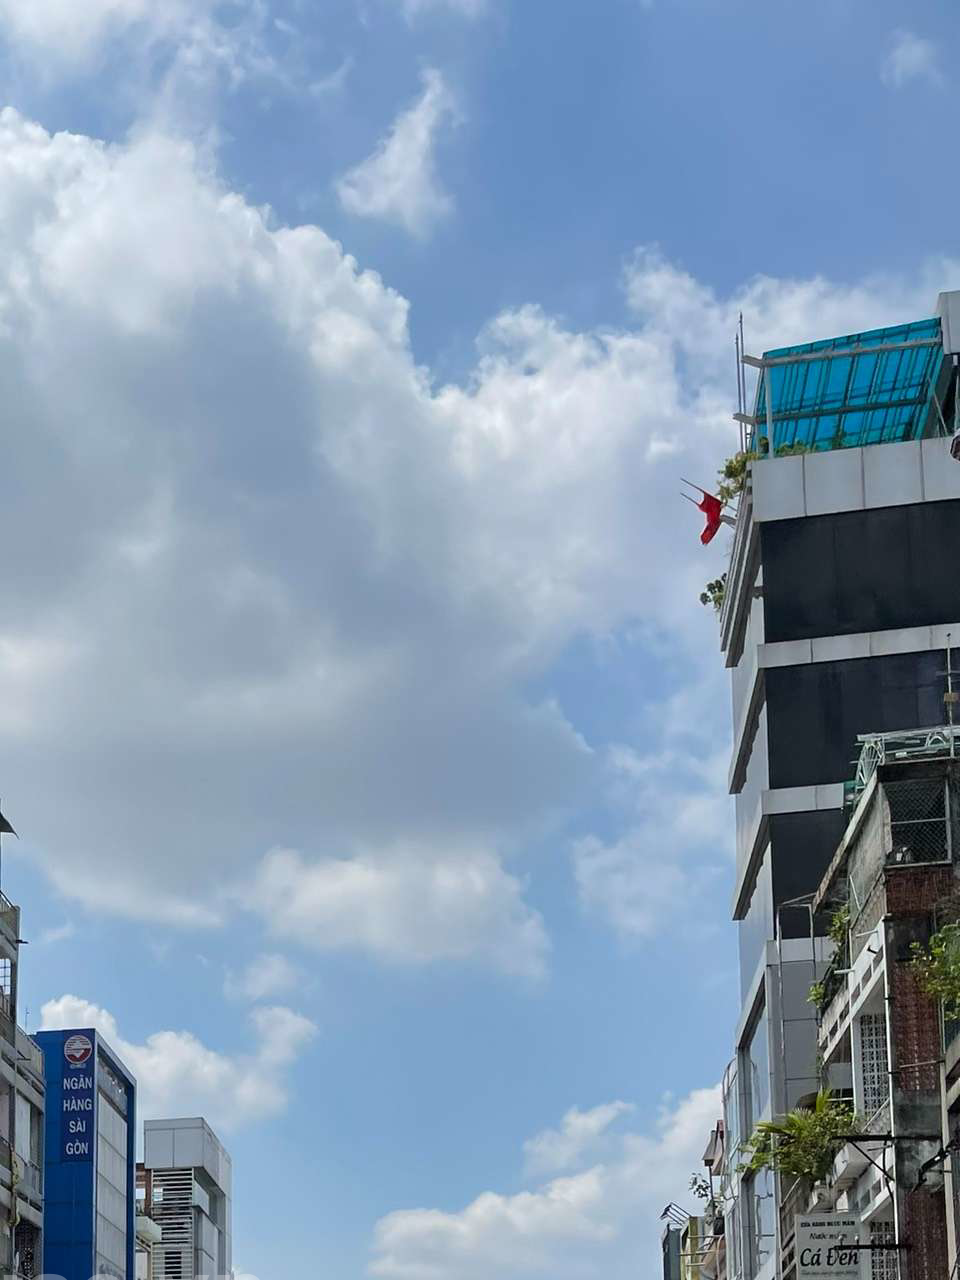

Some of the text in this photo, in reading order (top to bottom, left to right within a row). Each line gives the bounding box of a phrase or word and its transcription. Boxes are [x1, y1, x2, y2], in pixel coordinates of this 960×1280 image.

[63, 1098, 92, 1111] HÀNG
[69, 1118, 86, 1133] SÀI
[66, 1139, 88, 1155] GÒN
[800, 1248, 821, 1267] Cá
